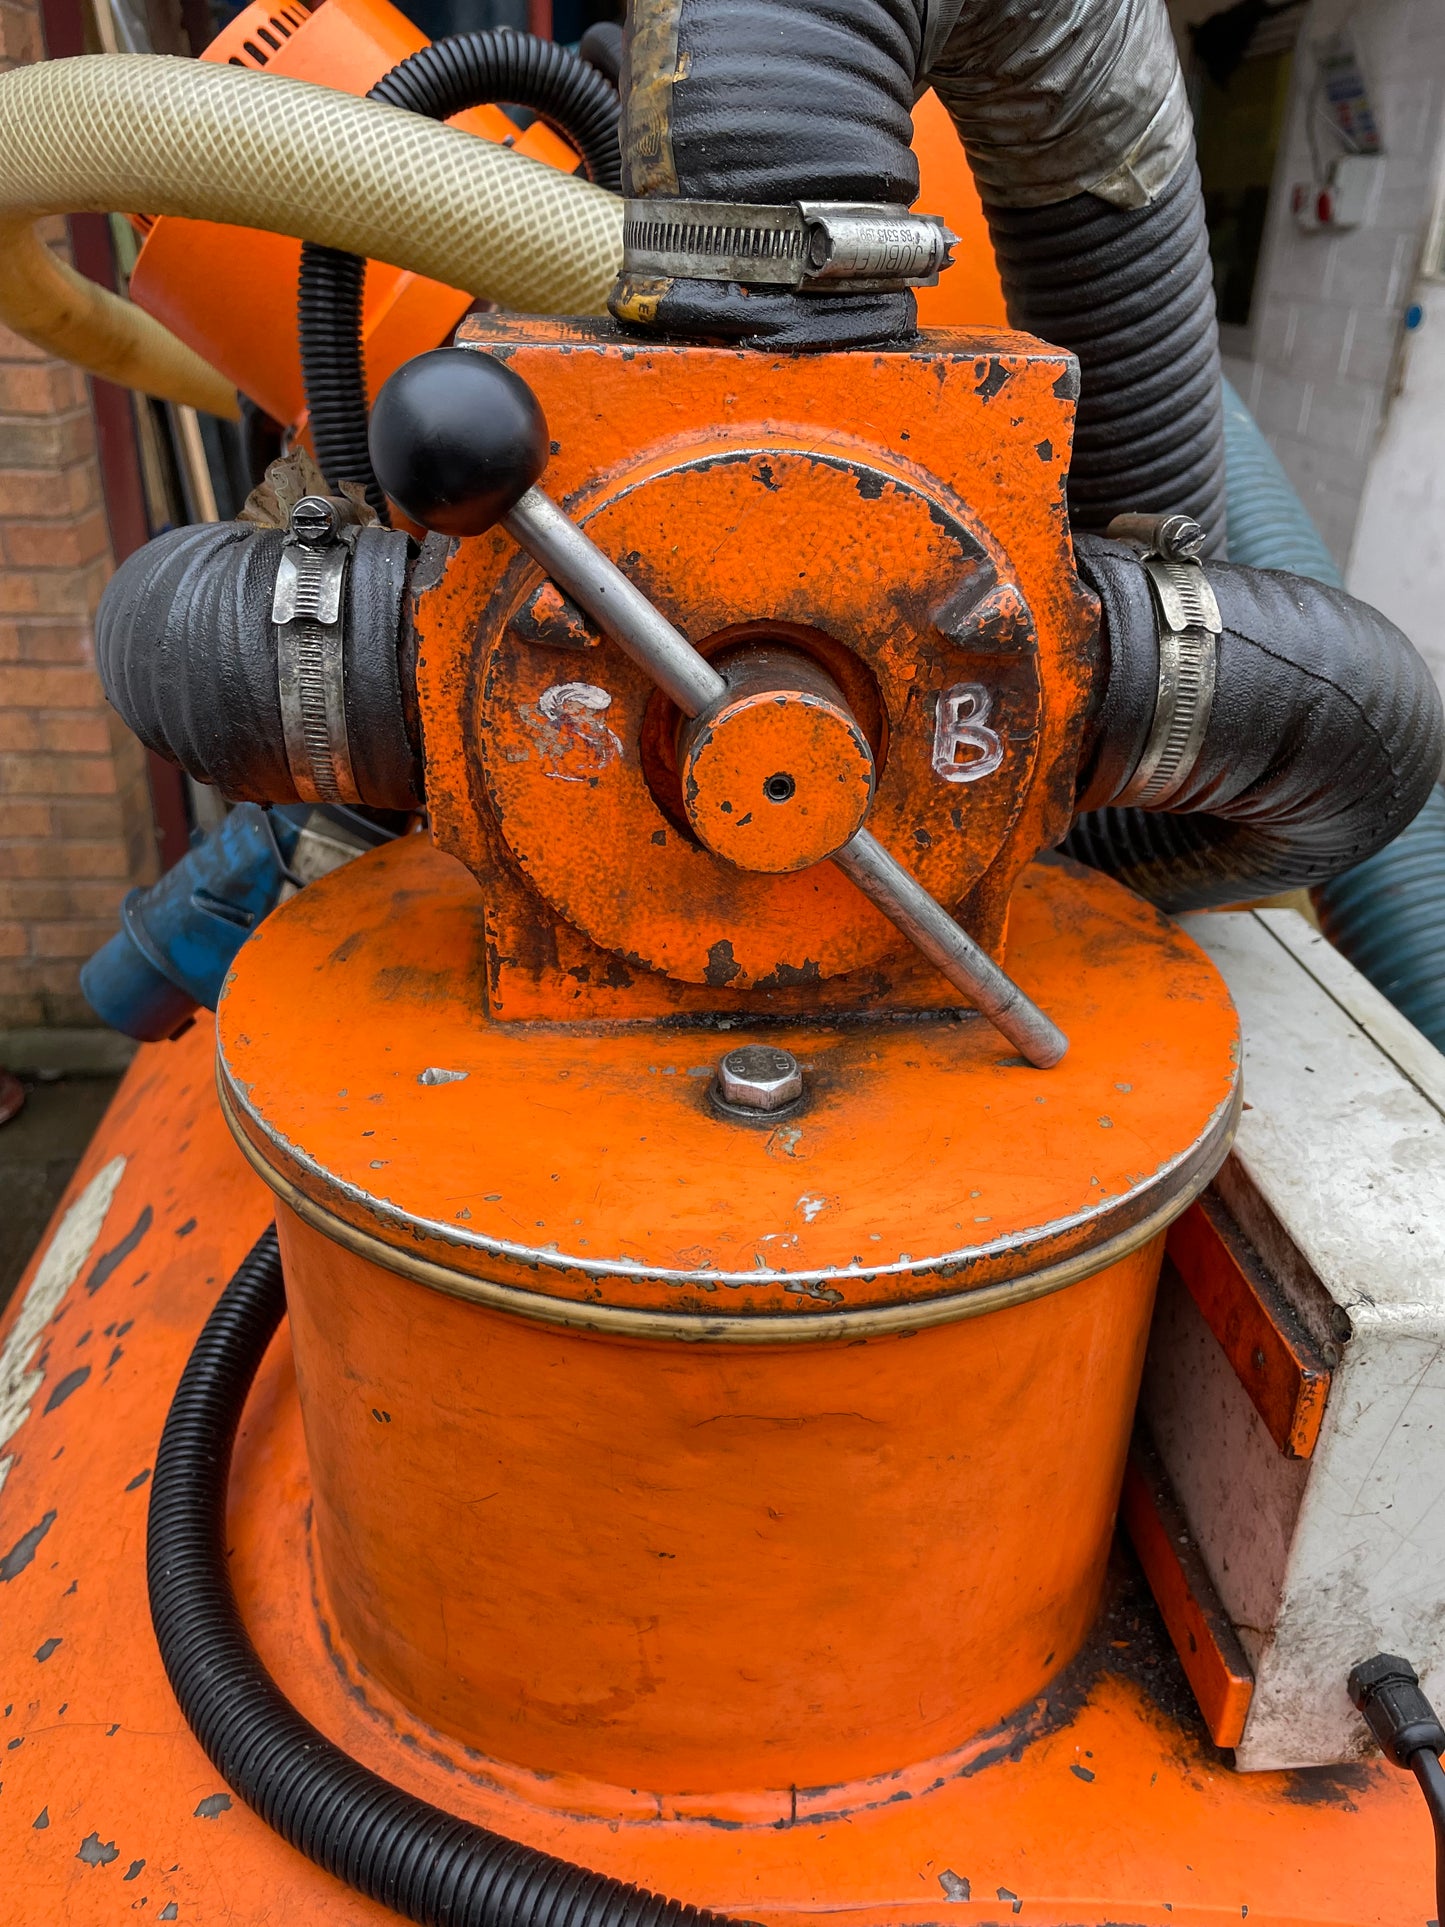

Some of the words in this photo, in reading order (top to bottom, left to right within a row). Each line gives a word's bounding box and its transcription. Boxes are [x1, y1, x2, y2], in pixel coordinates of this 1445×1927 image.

[878, 229, 899, 242] 5315
[900, 229, 913, 242] BS
[843, 245, 923, 271] JUBILEE
[932, 682, 1004, 782] B
